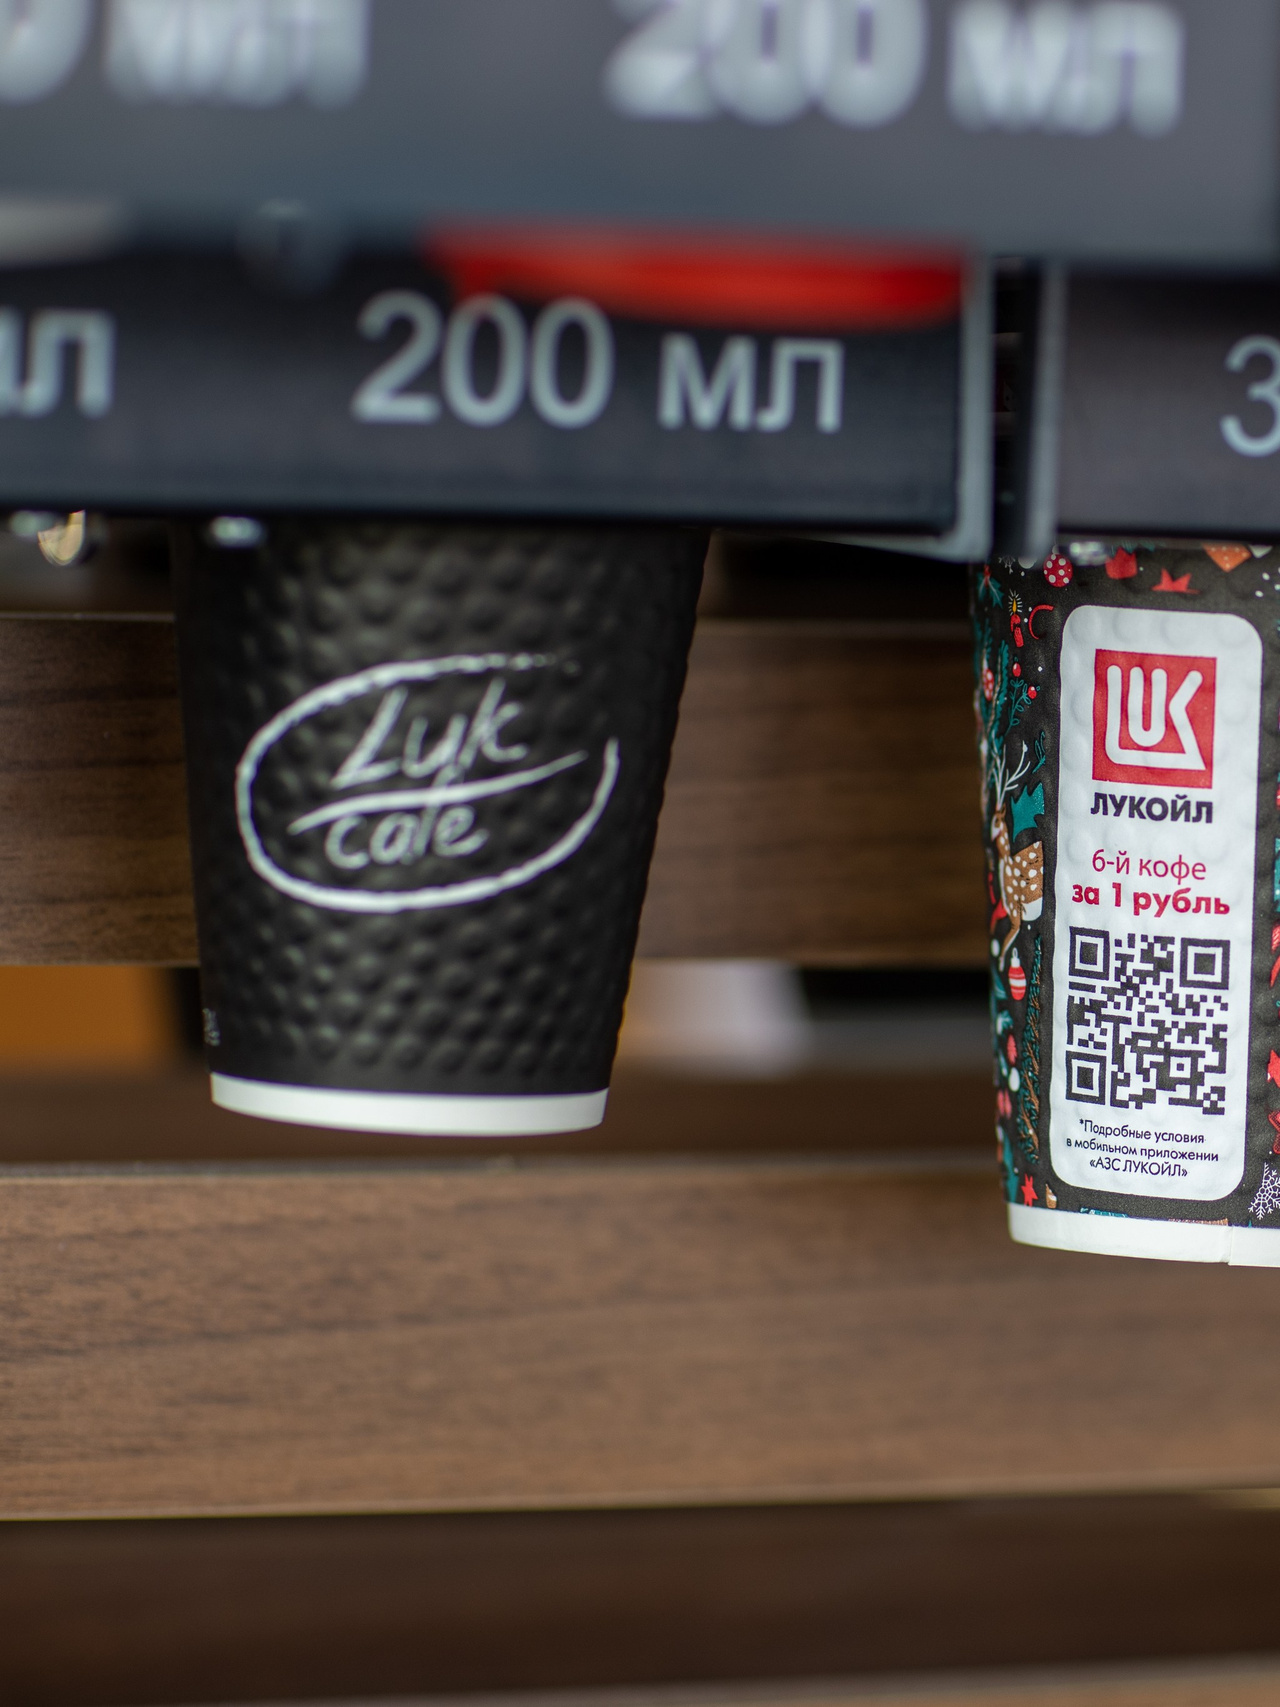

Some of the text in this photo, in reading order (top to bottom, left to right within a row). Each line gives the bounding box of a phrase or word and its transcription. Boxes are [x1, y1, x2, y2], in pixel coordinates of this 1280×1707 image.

[352, 290, 844, 431] 200 мл
[332, 677, 526, 788] Luk
[325, 765, 489, 868] cafe
[1091, 792, 1213, 823] ЛУКОЙЛ
[1092, 849, 1207, 884] 6-й кофе
[1072, 883, 1231, 917] за 1 рубль
[1066, 1137, 1219, 1162] в мобильном приложении
[1154, 1131, 1205, 1144] условия
[1089, 1156, 1188, 1178] «АЗС ЛУКОЙЛ»
